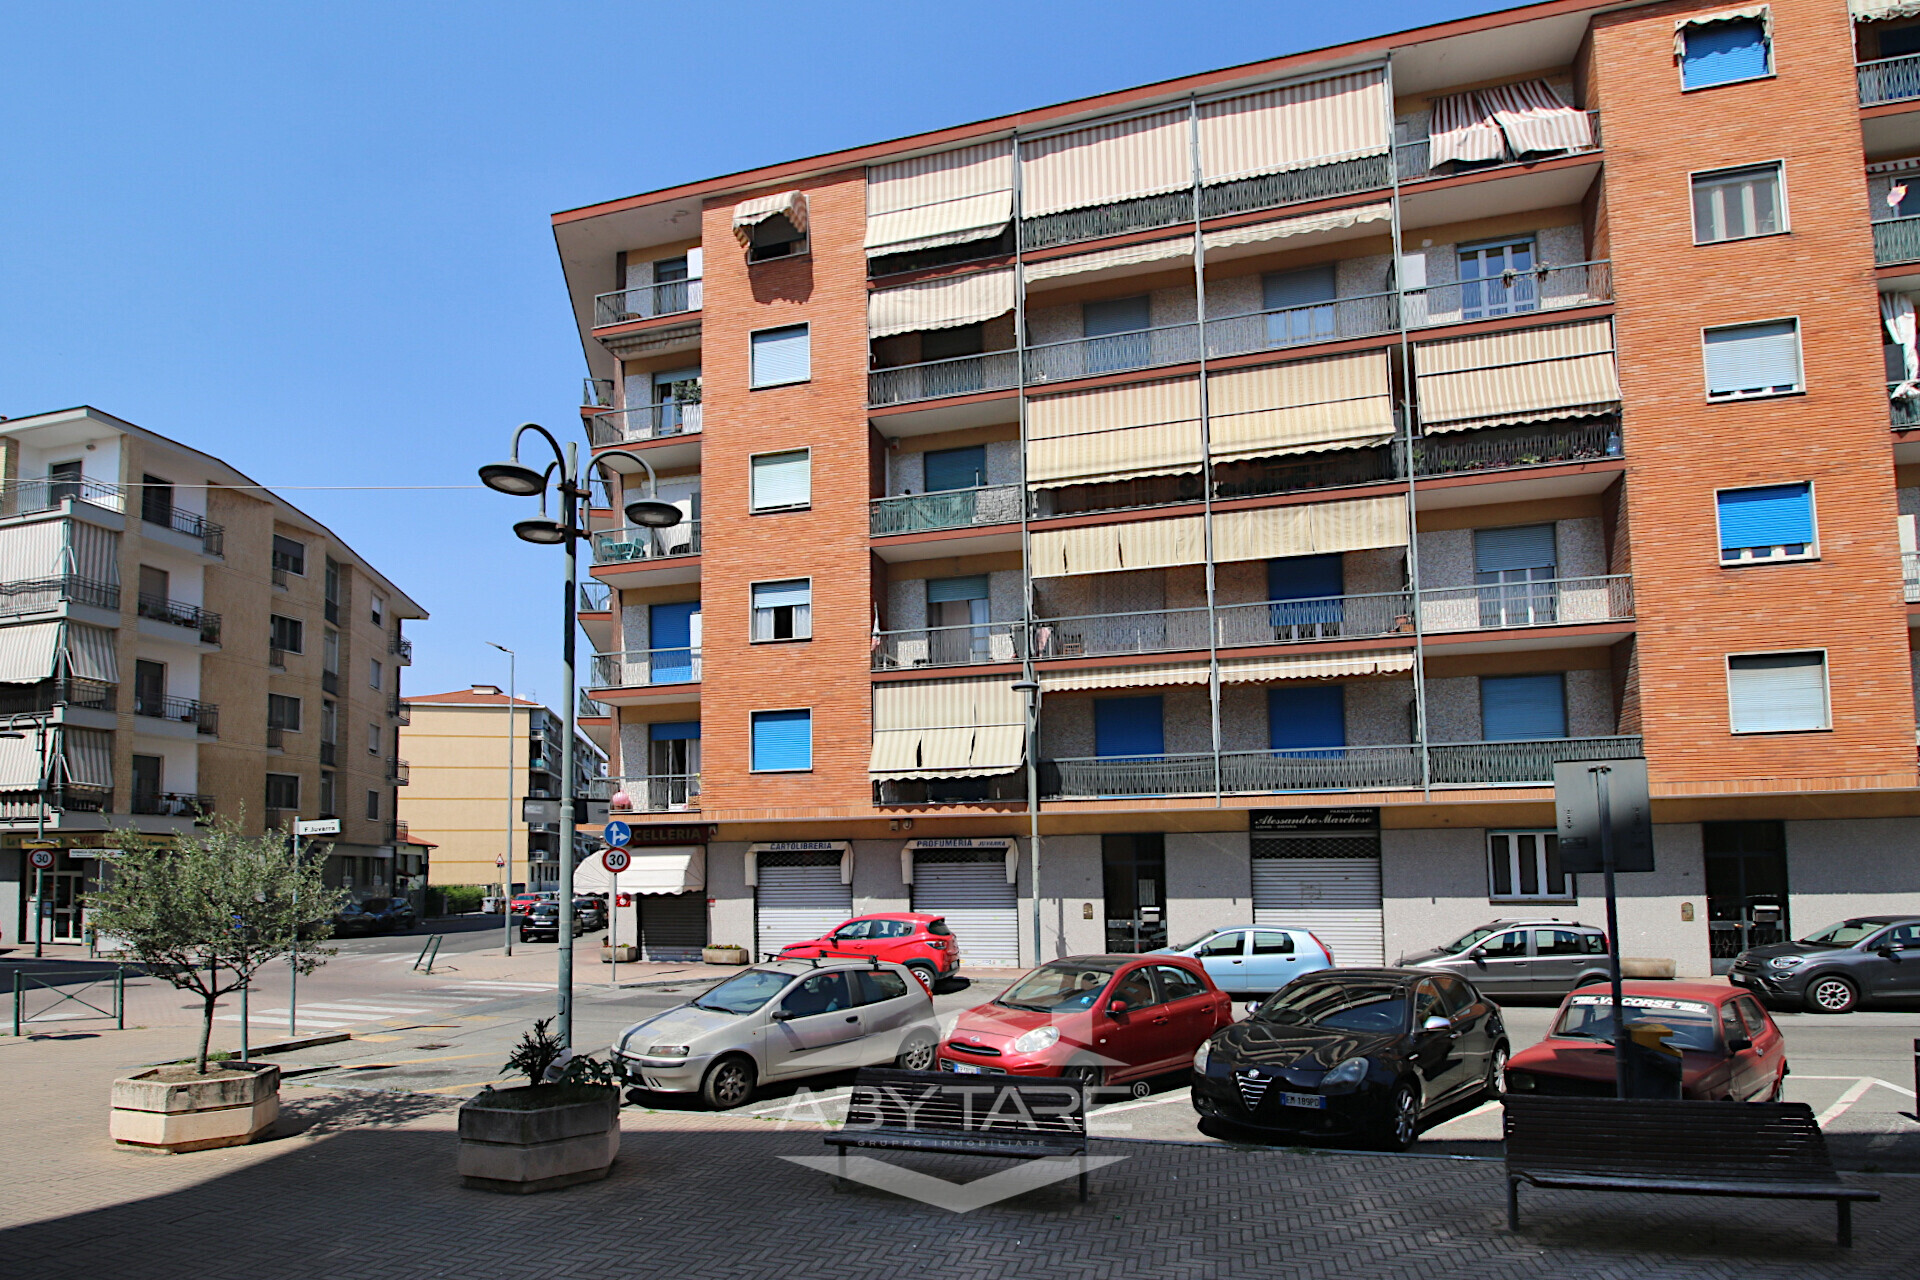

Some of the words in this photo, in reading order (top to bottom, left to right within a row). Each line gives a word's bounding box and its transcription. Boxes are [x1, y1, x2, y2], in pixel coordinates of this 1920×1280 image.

[1255, 814, 1318, 825] Alessandro
[1319, 814, 1372, 824] Marchese
[633, 828, 702, 841] CELLERIA
[770, 842, 832, 850] CARTOLIBRERIA
[917, 839, 972, 848] PROFUMERIA
[36, 853, 49, 863] 30
[609, 854, 624, 866] 30
[1621, 997, 1676, 1010] CORSE
